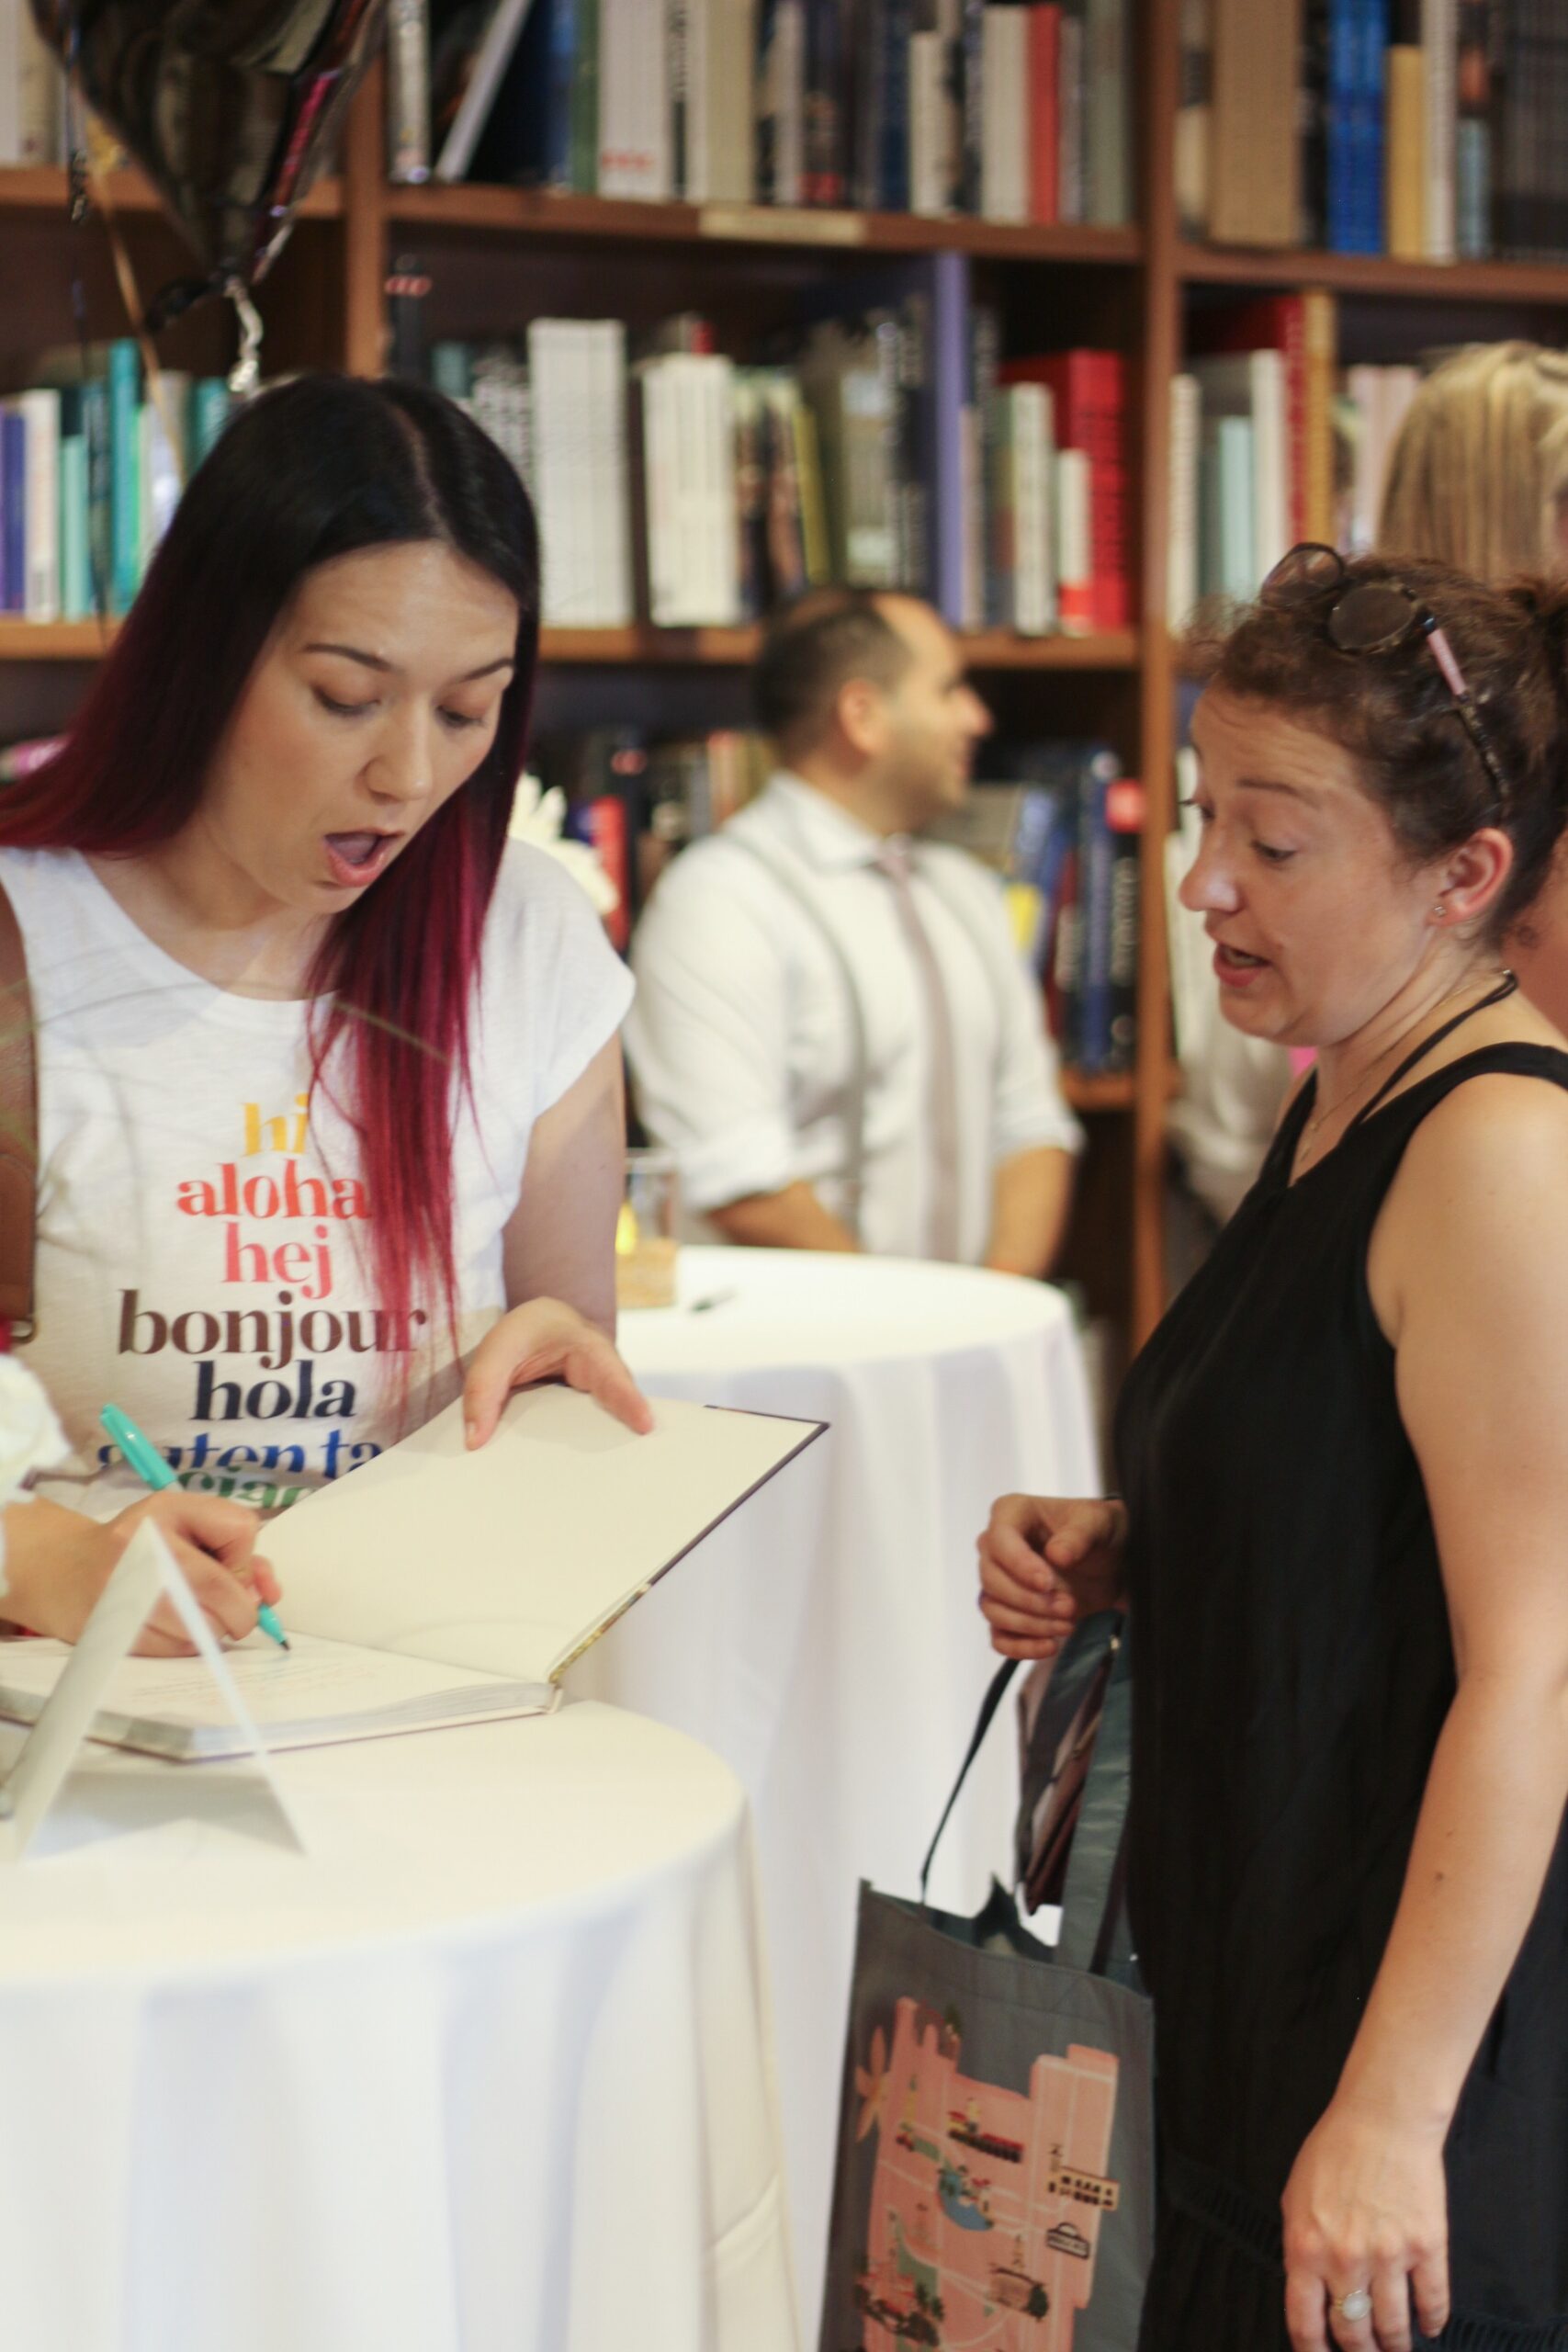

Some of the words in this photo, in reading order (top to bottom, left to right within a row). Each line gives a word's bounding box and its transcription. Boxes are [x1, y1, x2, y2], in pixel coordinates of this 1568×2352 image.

[242, 1093, 309, 1157] hi
[176, 1159, 372, 1220] aloha
[220, 1222, 333, 1299] hej
[118, 1289, 426, 1370] bonjour
[189, 1359, 357, 1419] hola
